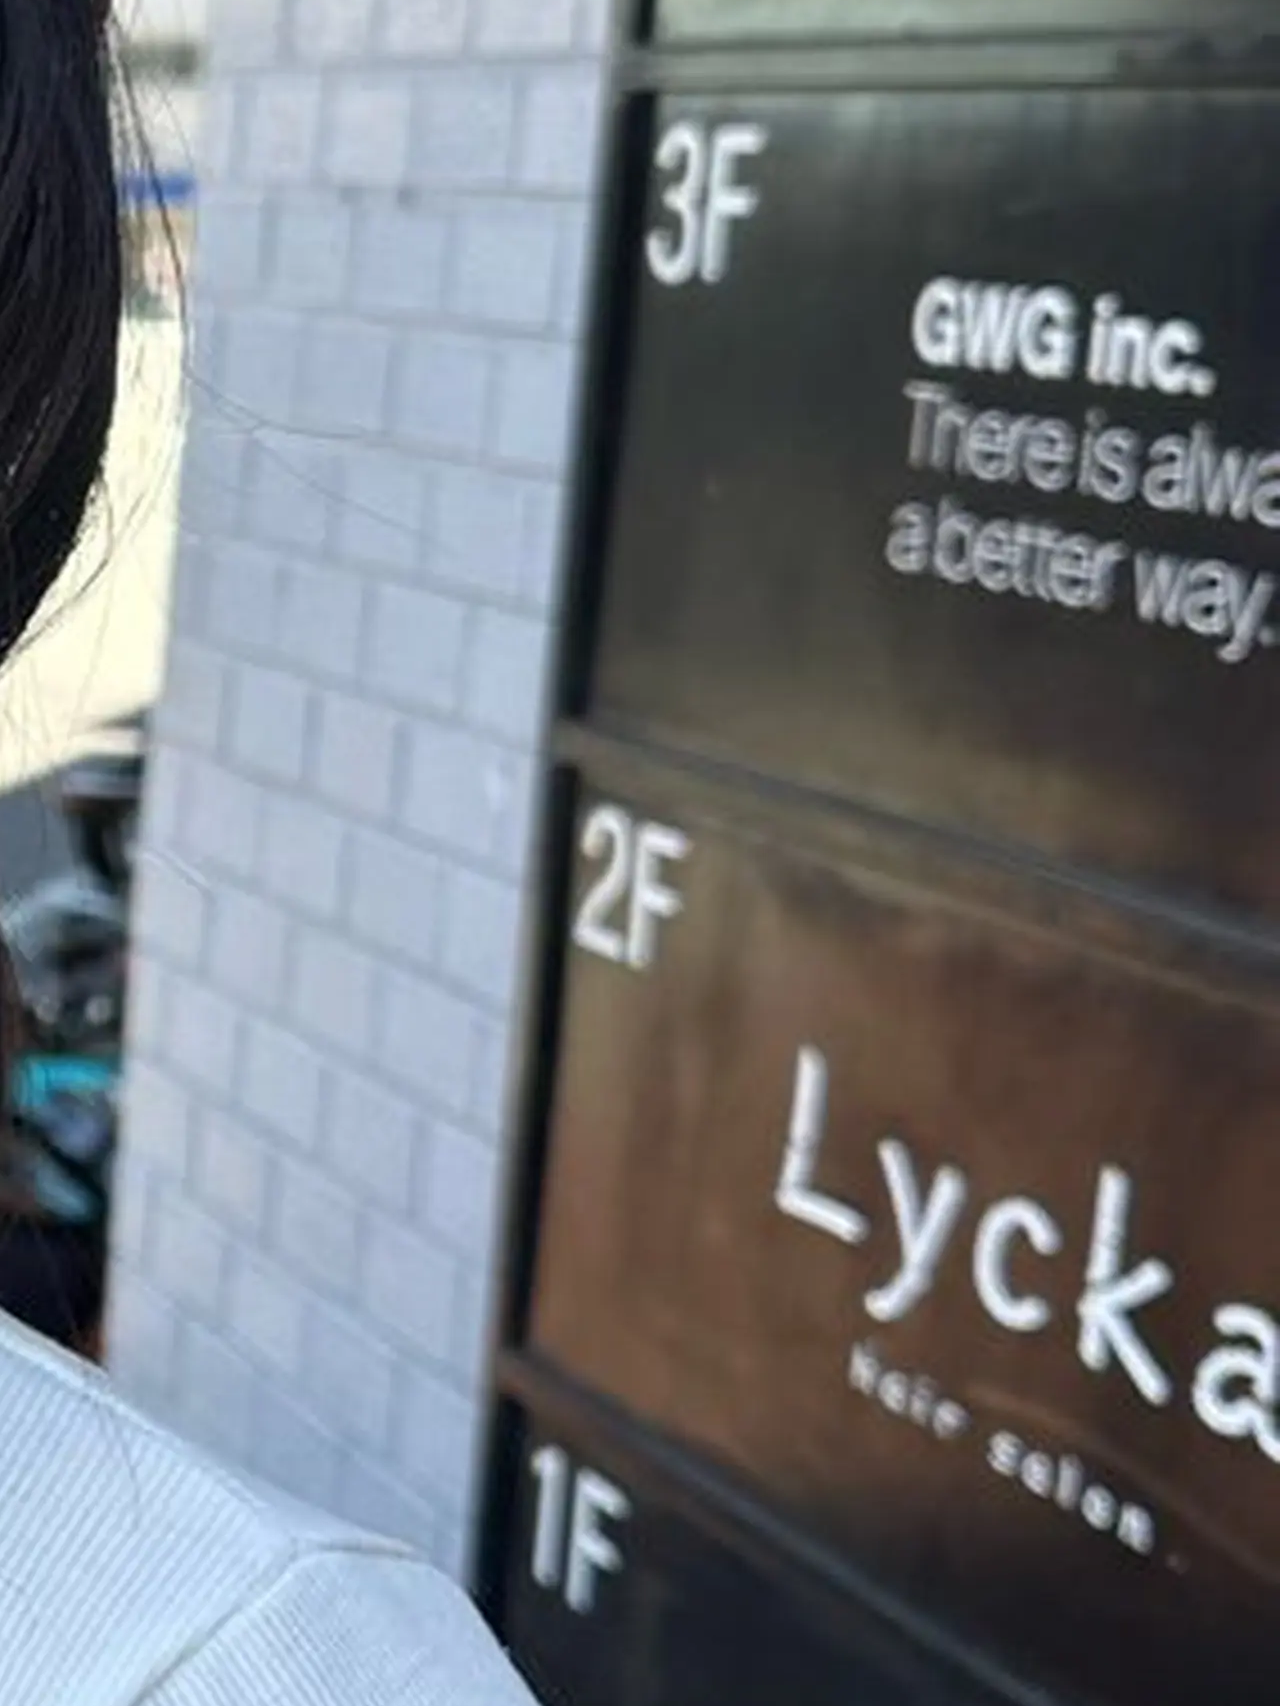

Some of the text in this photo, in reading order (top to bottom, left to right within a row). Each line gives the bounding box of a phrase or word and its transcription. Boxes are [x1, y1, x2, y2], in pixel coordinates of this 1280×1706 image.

[646, 120, 769, 284] 3F
[911, 276, 1217, 397] GWG inc.
[902, 378, 1078, 492] There
[1077, 406, 1141, 503] is
[885, 500, 932, 574] a
[933, 496, 1128, 613] better
[573, 804, 695, 968] 2F
[775, 1044, 1280, 1464] Lycka
[529, 1444, 634, 1616] 1F
